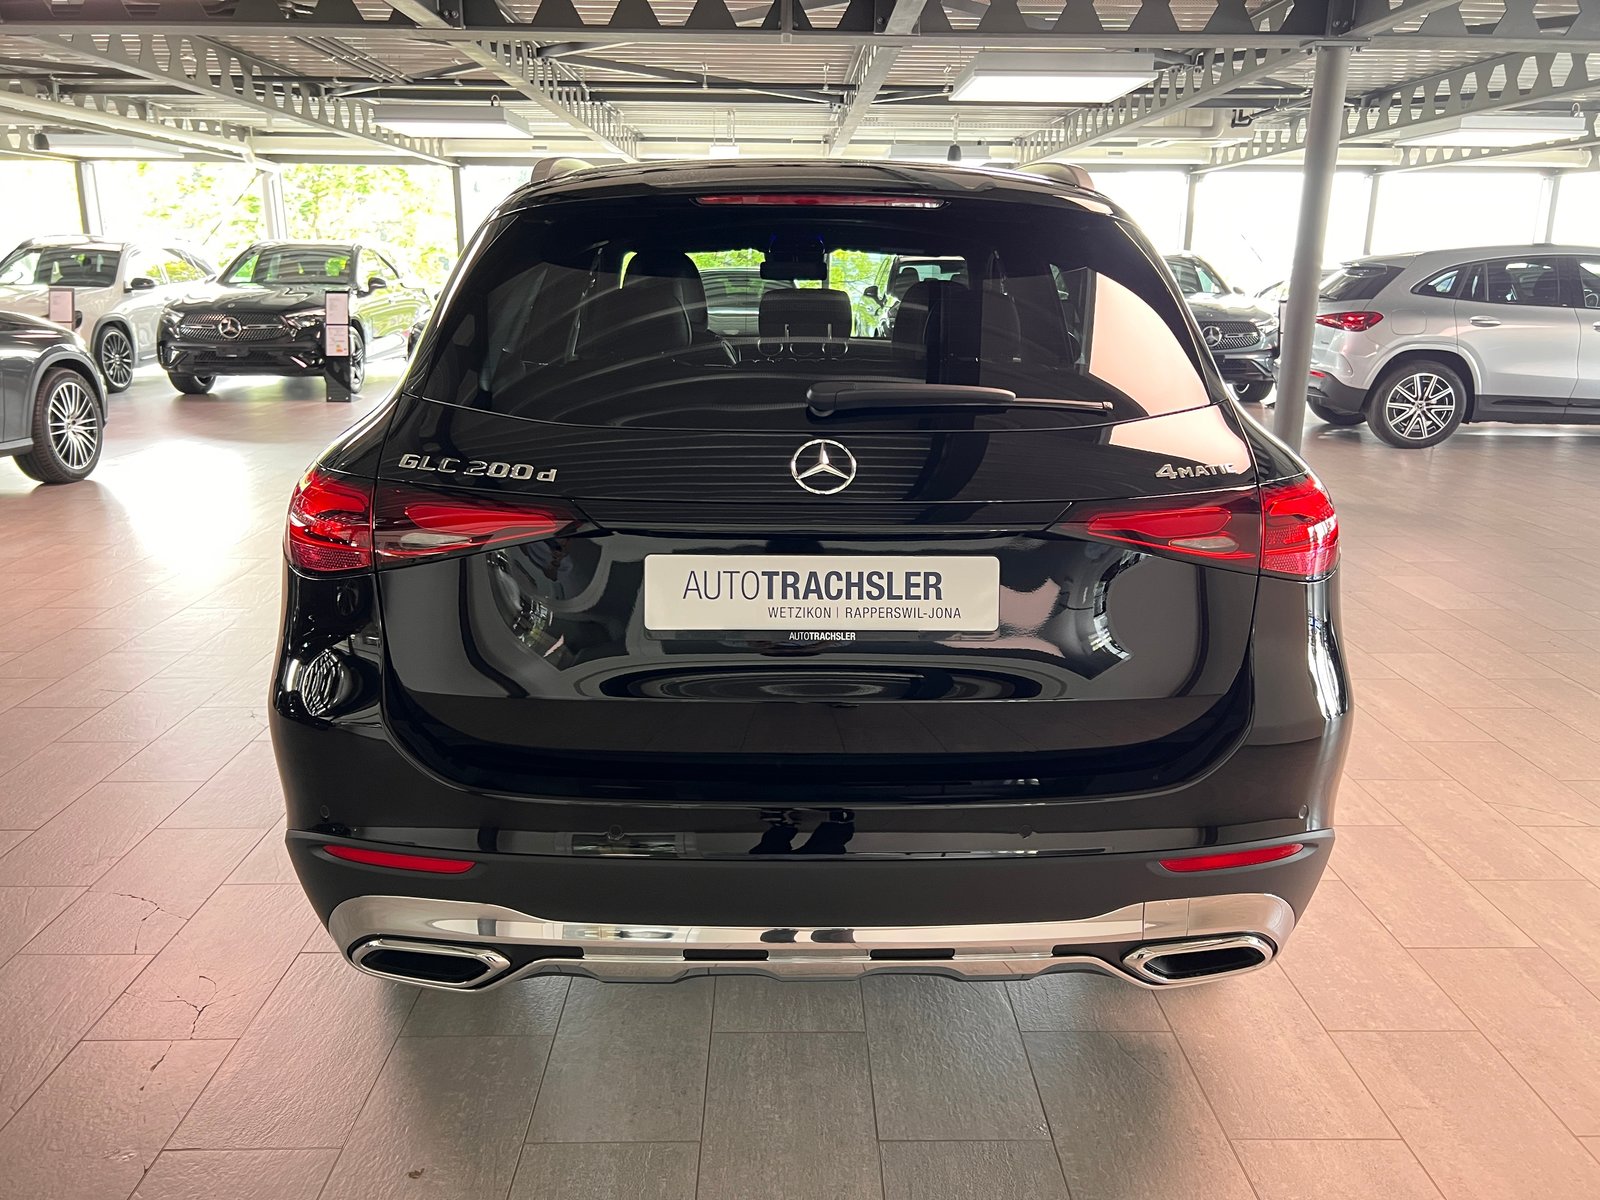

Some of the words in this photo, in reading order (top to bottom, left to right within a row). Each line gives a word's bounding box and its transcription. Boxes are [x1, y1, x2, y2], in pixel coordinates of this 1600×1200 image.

[398, 453, 461, 473] GLC
[682, 570, 943, 601] AUTOTRACHSLER
[767, 606, 831, 619] WETZIKON
[844, 607, 962, 619] RAPPERSWIL-JONA
[788, 631, 857, 641] AUTOTRACHSLER
